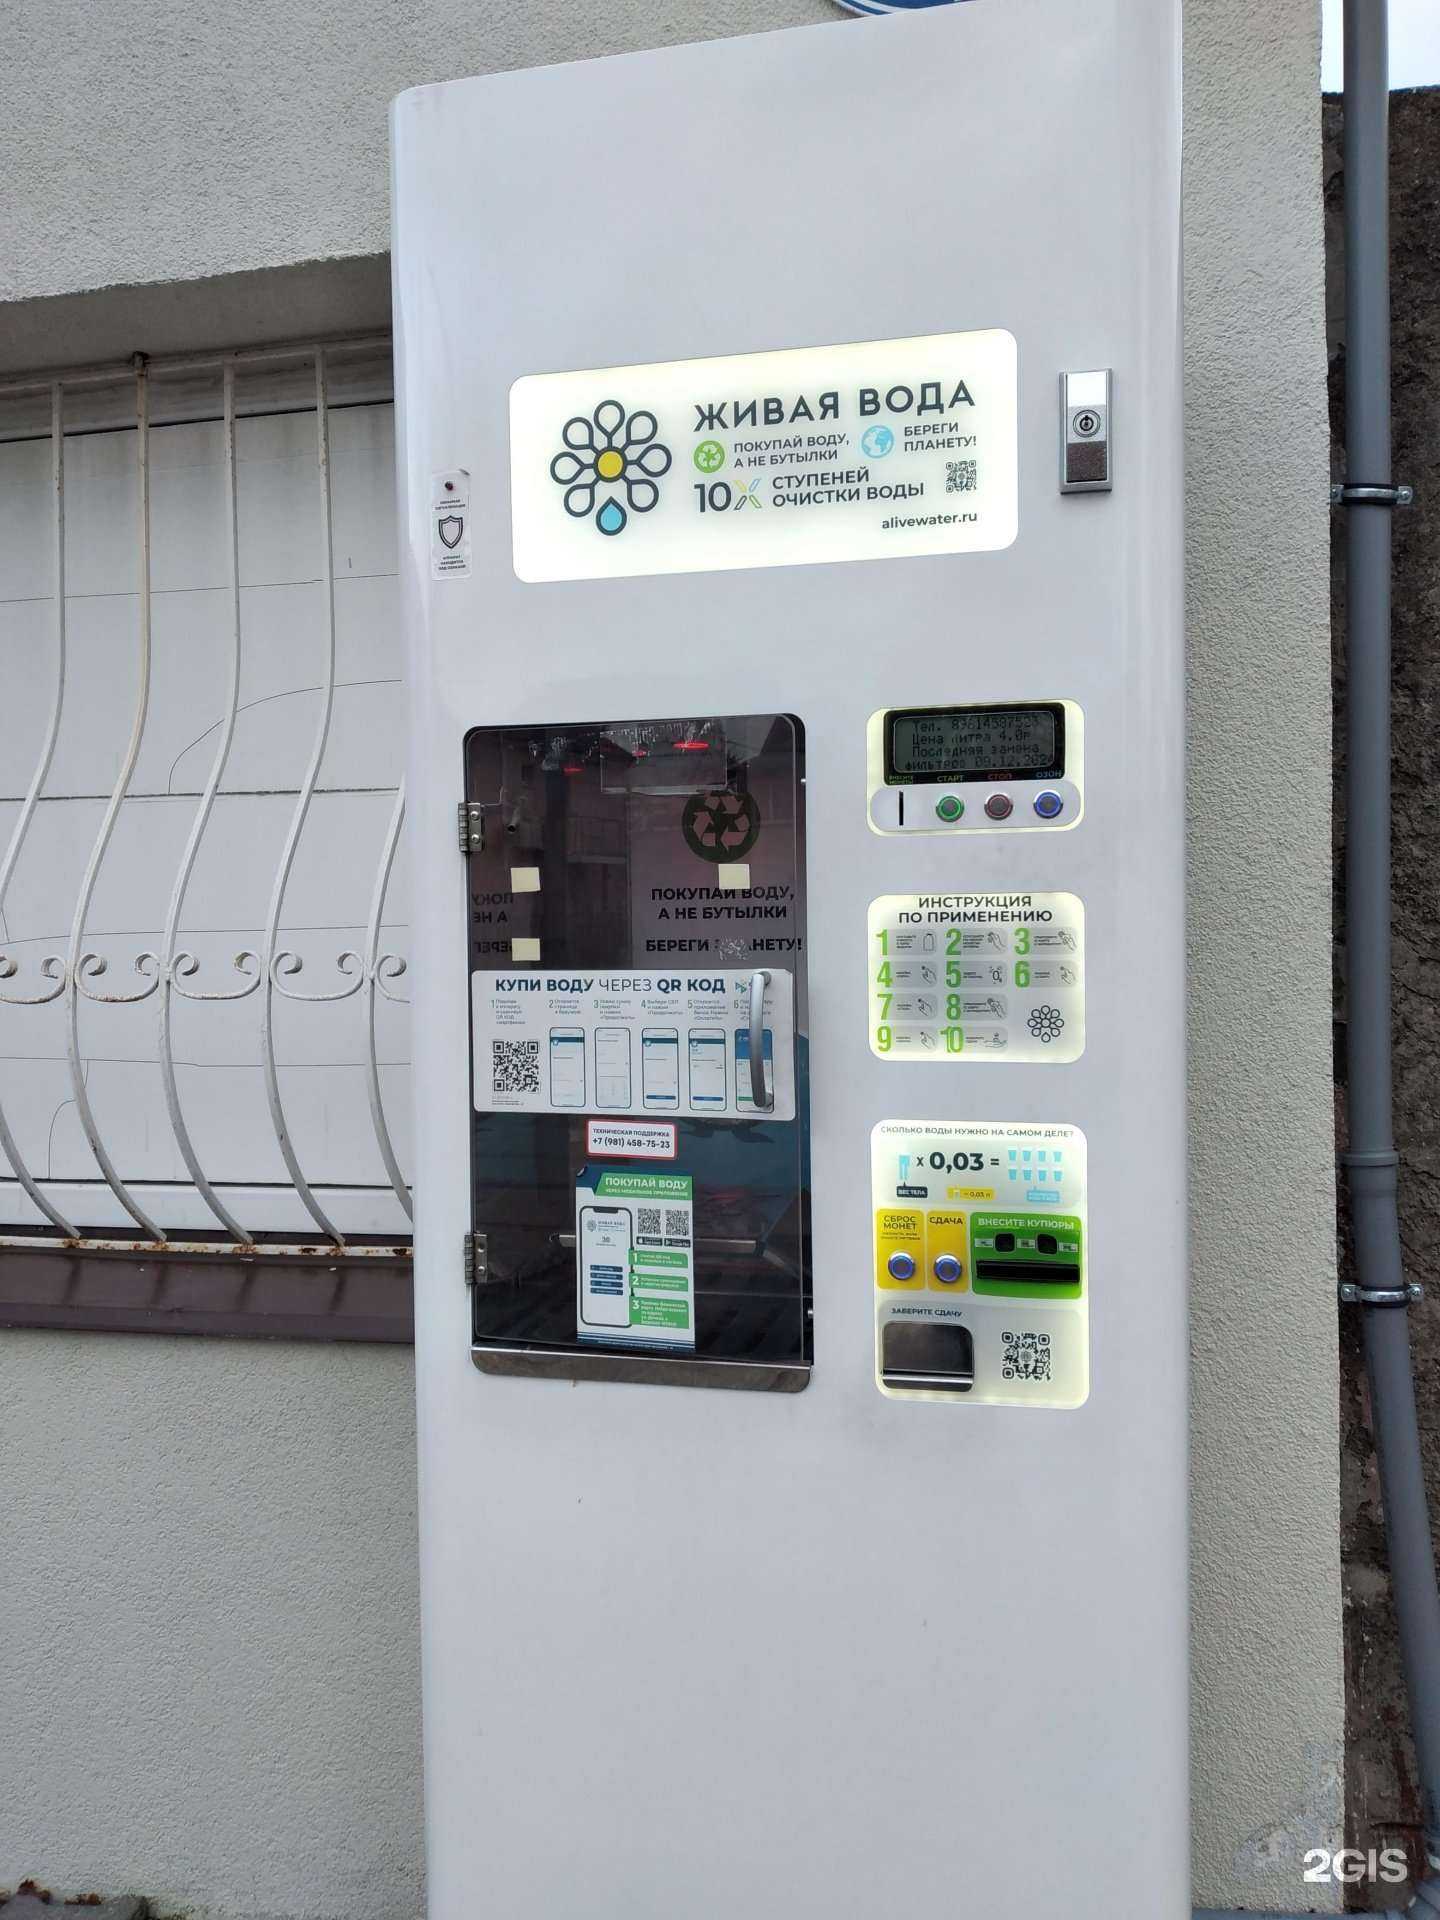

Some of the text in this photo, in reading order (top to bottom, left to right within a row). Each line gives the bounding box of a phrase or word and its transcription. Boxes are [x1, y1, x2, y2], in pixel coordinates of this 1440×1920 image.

[694, 379, 976, 433] ЖИВАЯ ВОДА
[904, 420, 960, 438] БЕРЕГИ
[734, 432, 850, 454] ПОКУПАЙ ВОДУ,
[904, 435, 977, 453] ПЛАНЕТУ!
[734, 449, 839, 469] А НЕ БУТЫЛКИ
[772, 467, 869, 491] СТУПЕНЕЙ
[772, 481, 925, 509] ОЧИСТКИ ВОДЫ
[881, 511, 978, 531] alivewater.ru
[937, 775, 964, 783] СТАРТ
[988, 773, 1013, 781] СТОП
[1036, 770, 1062, 778] ОЗОН
[918, 895, 1032, 909] ИНСТРУКЦИЯ
[658, 905, 787, 920] А НЕ БУТЫЛКИ
[899, 910, 1053, 924] ПО ПРИМЕНЕНИЮ
[646, 938, 709, 952] БЕРЕГИ
[876, 928, 888, 956] 1
[945, 928, 962, 956] 2
[1014, 927, 1031, 955] 3
[877, 961, 893, 988] 4
[946, 960, 961, 988] 5
[1014, 960, 1031, 988] 6
[495, 978, 726, 994] КУПИ ВОДУ ЧЕРЕЗ QR КОД
[877, 993, 893, 1020] 7
[946, 993, 961, 1020] 8
[877, 1026, 892, 1052] 9
[940, 1026, 964, 1053] 10
[593, 1128, 632, 1136] ТЕХНИЧЕСКАЯ
[880, 1126, 923, 1135] СКОЛЬКО
[925, 1127, 952, 1135] ВОДЫ
[954, 1128, 989, 1136] НУЖНО
[1006, 1128, 1042, 1137] САМОМ
[1044, 1129, 1074, 1138] ДЕЛЕ?
[604, 1138, 625, 1148] (981)
[627, 1139, 670, 1149] 458-75-23
[929, 1151, 984, 1174] 0,03
[606, 1176, 688, 1191] ПОКУПАЙ ВОДУ
[884, 1215, 916, 1223] СБРОС
[884, 1222, 917, 1230] МОНЕТ
[929, 1216, 963, 1226] СДАЧА
[978, 1218, 1075, 1230] ВНЕСИТЕ КУПЮРЫ
[633, 1252, 638, 1263] 1
[632, 1275, 640, 1286] 2
[632, 1299, 640, 1310] 3
[891, 1307, 962, 1318] ЗАБЕРИТЕ СДАЧУ
